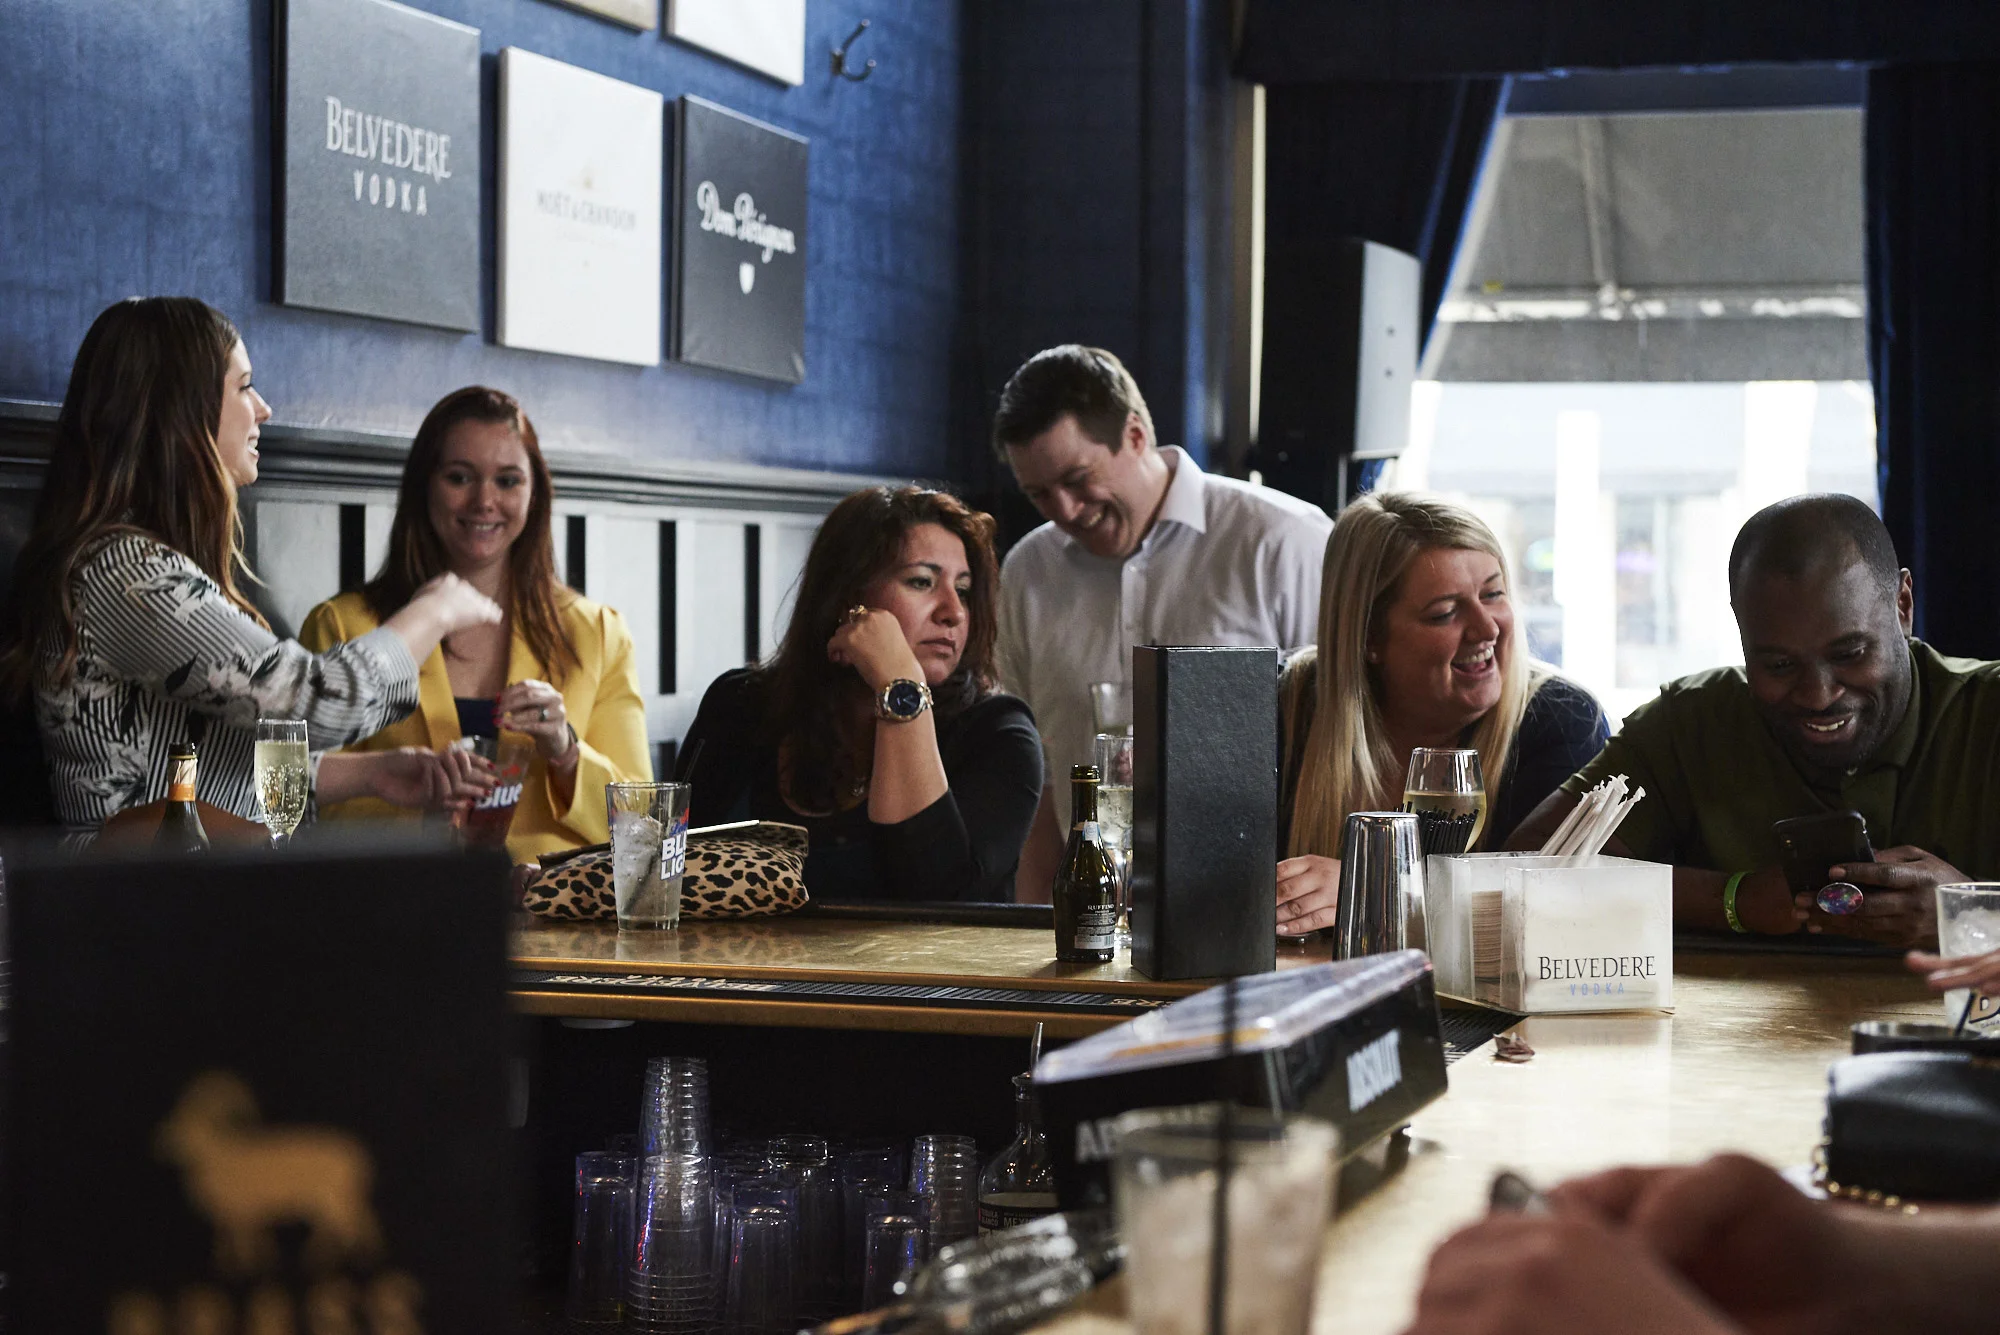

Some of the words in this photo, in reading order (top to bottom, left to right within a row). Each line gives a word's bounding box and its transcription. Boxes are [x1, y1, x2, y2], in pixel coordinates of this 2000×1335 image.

[325, 95, 452, 184] BELVEDERE
[353, 168, 428, 216] VODKA
[697, 180, 737, 237] Dom
[1537, 955, 1656, 980] BELVEDERE
[1570, 982, 1625, 996] VODKA
